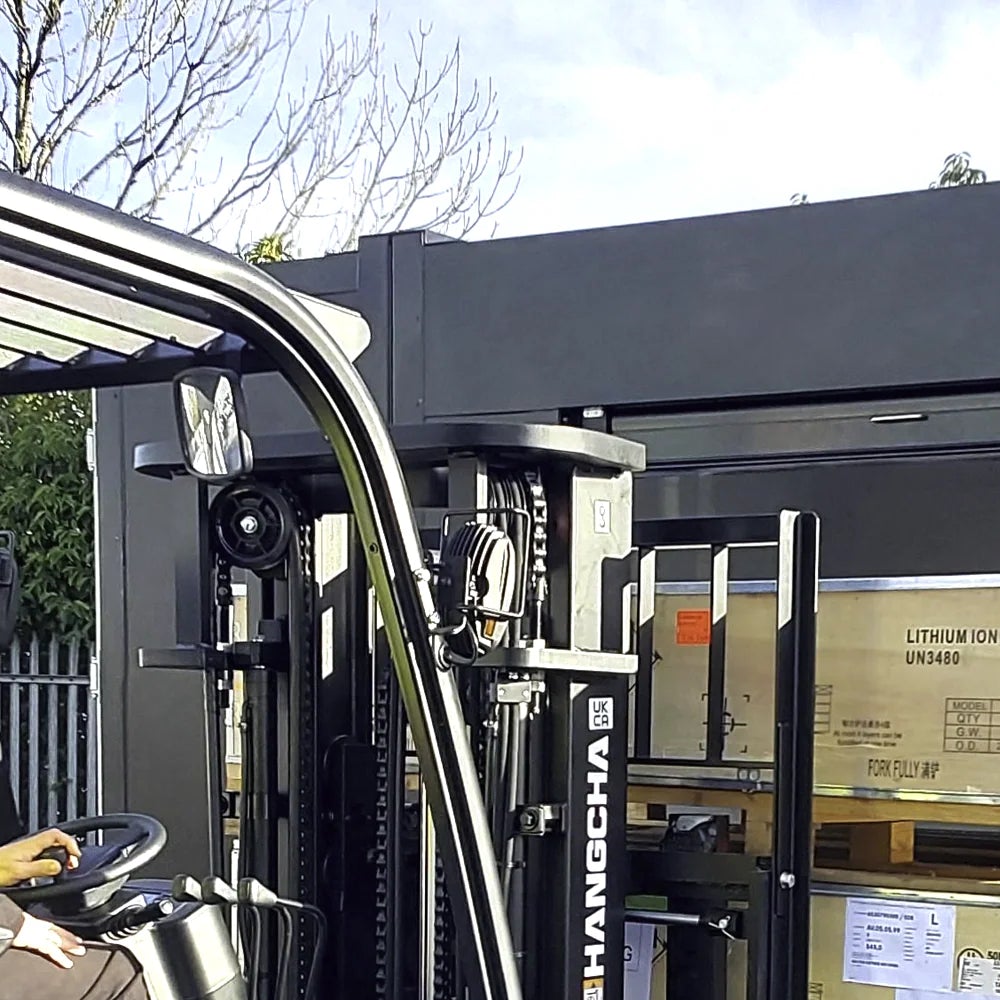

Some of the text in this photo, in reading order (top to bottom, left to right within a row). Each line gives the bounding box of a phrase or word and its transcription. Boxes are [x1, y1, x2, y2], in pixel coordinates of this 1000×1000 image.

[906, 628, 968, 645] LITHIUM
[970, 628, 999, 645] ION
[905, 649, 960, 666] UN3480
[593, 700, 609, 713] UK
[952, 701, 987, 711] MODEL
[593, 714, 609, 727] CA
[956, 713, 980, 724] QTY
[868, 759, 891, 778] FORK
[893, 760, 920, 779] FULLY
[584, 735, 609, 978] HANGCHA
[931, 913, 939, 926] L
